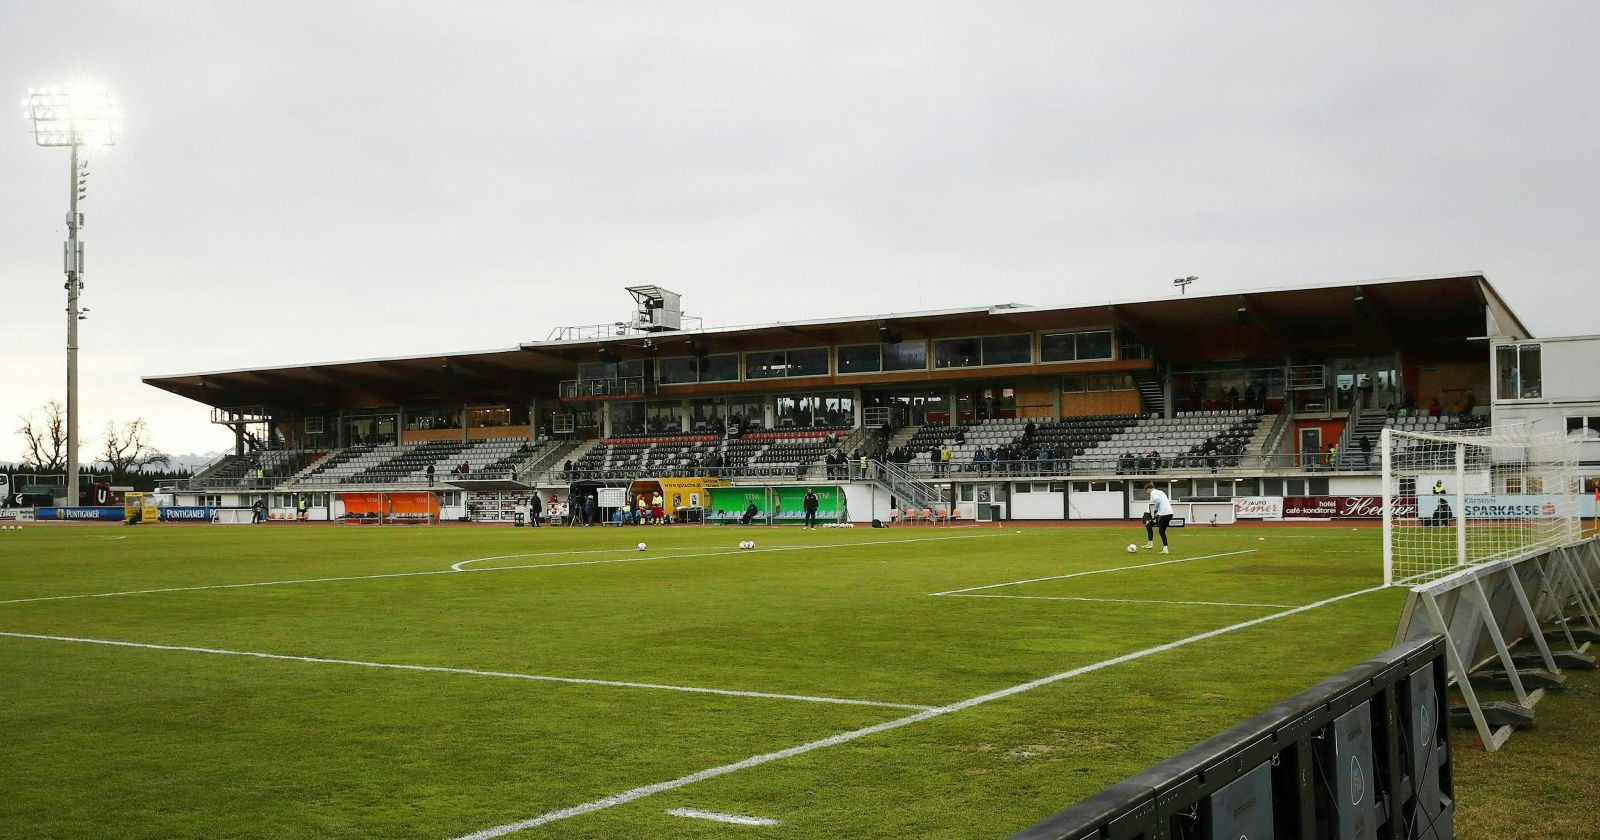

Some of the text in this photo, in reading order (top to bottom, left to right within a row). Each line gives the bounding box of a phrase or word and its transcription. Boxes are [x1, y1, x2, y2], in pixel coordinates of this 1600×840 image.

[66, 509, 100, 518] PUNTIGAMER
[167, 509, 205, 519] PUNTIGAMER
[1465, 505, 1540, 516] SPARKASSE
